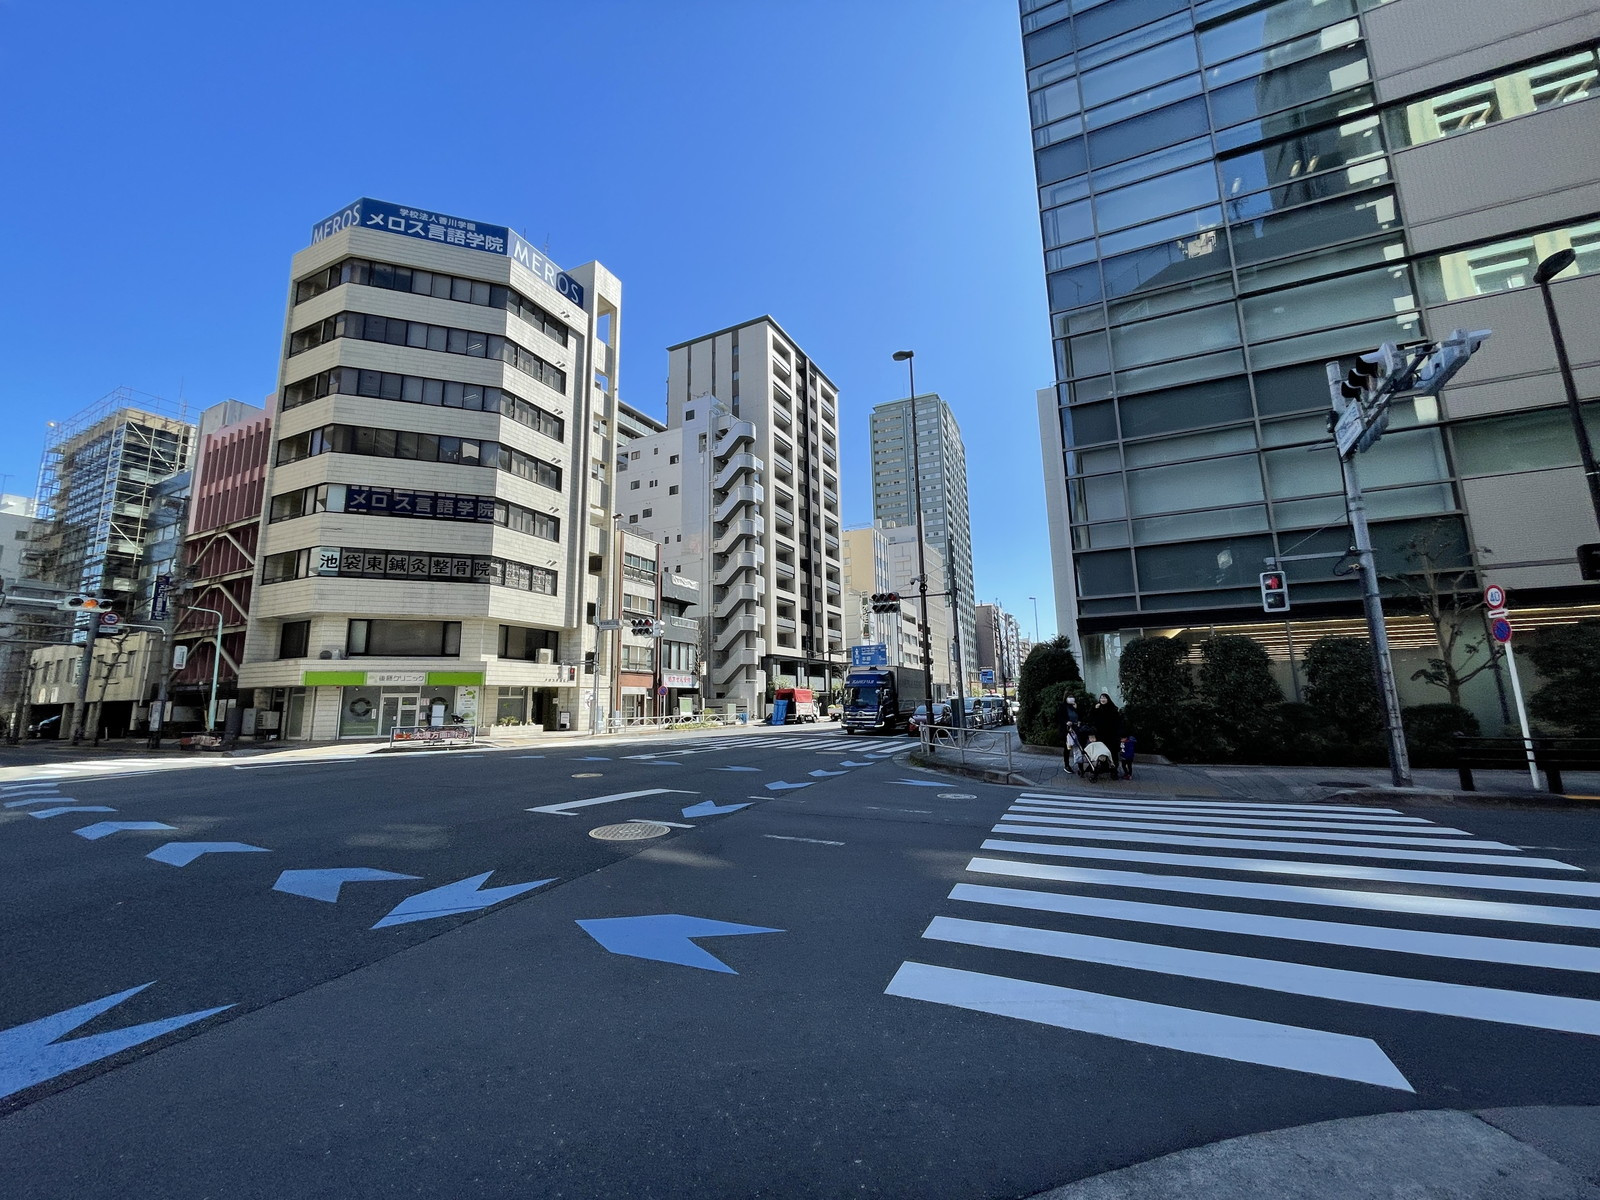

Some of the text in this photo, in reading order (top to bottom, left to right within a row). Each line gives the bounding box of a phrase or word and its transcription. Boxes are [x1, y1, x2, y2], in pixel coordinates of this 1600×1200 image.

[312, 204, 361, 246] MEROS
[366, 213, 504, 252] メロス言語学院
[513, 240, 579, 304] MEROS
[351, 493, 494, 517] メロス言語学院
[320, 554, 490, 576] 池袋東鍼灸整骨院
